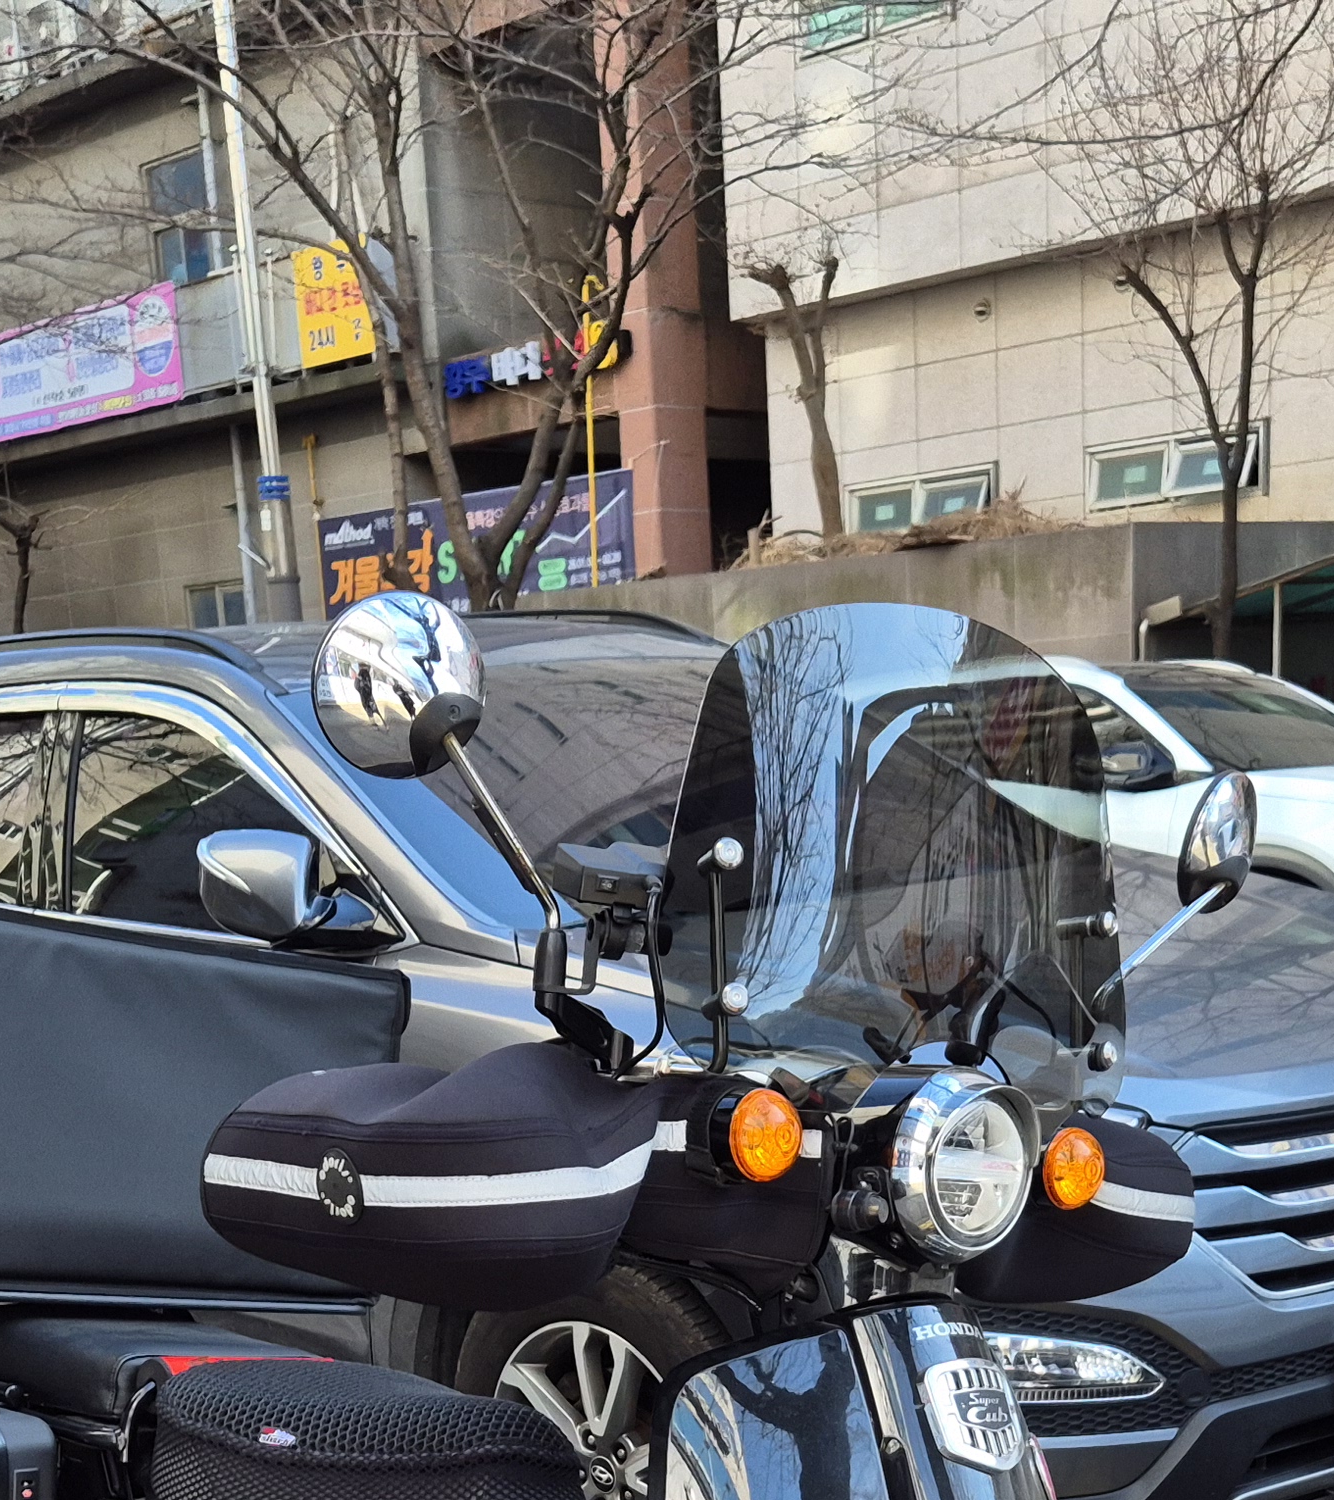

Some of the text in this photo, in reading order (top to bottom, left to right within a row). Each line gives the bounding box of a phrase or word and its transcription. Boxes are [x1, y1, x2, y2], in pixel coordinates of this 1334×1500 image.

[912, 1322, 984, 1341] HONDA
[968, 1392, 1001, 1406] Super
[967, 1406, 1008, 1424] Cub
